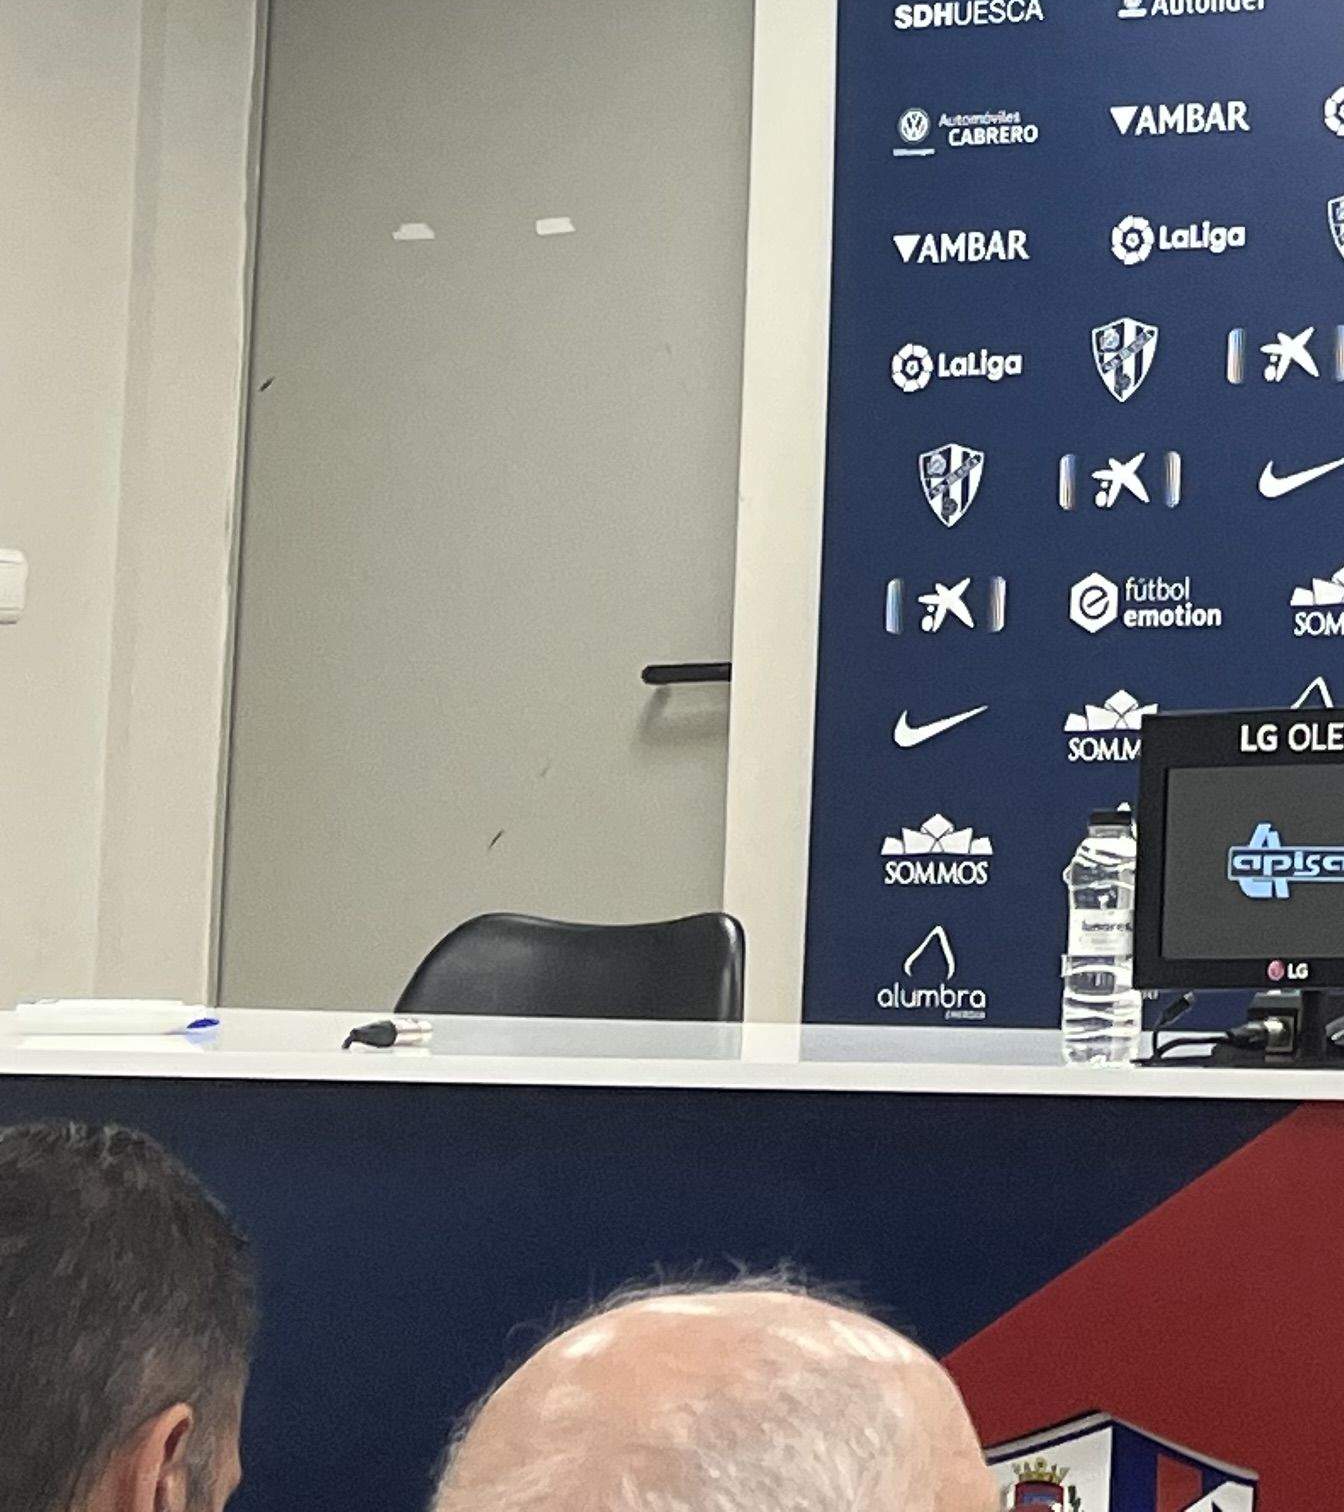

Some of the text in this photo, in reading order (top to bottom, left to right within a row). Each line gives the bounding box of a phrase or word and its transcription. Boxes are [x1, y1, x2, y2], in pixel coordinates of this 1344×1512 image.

[1135, 101, 1250, 135] AMBAR
[949, 125, 1038, 146] CABRERO
[917, 230, 1030, 263] AMBAR
[1159, 220, 1245, 253] LaLiga
[938, 349, 1022, 381] LaLiga
[1126, 576, 1190, 601] fútbol
[1124, 602, 1221, 627] emotion
[1068, 737, 1141, 761] SOMM
[1241, 724, 1278, 753] LG
[885, 861, 988, 884] SOMMOS
[1287, 963, 1308, 980] LG
[878, 982, 985, 1008] alumbra
